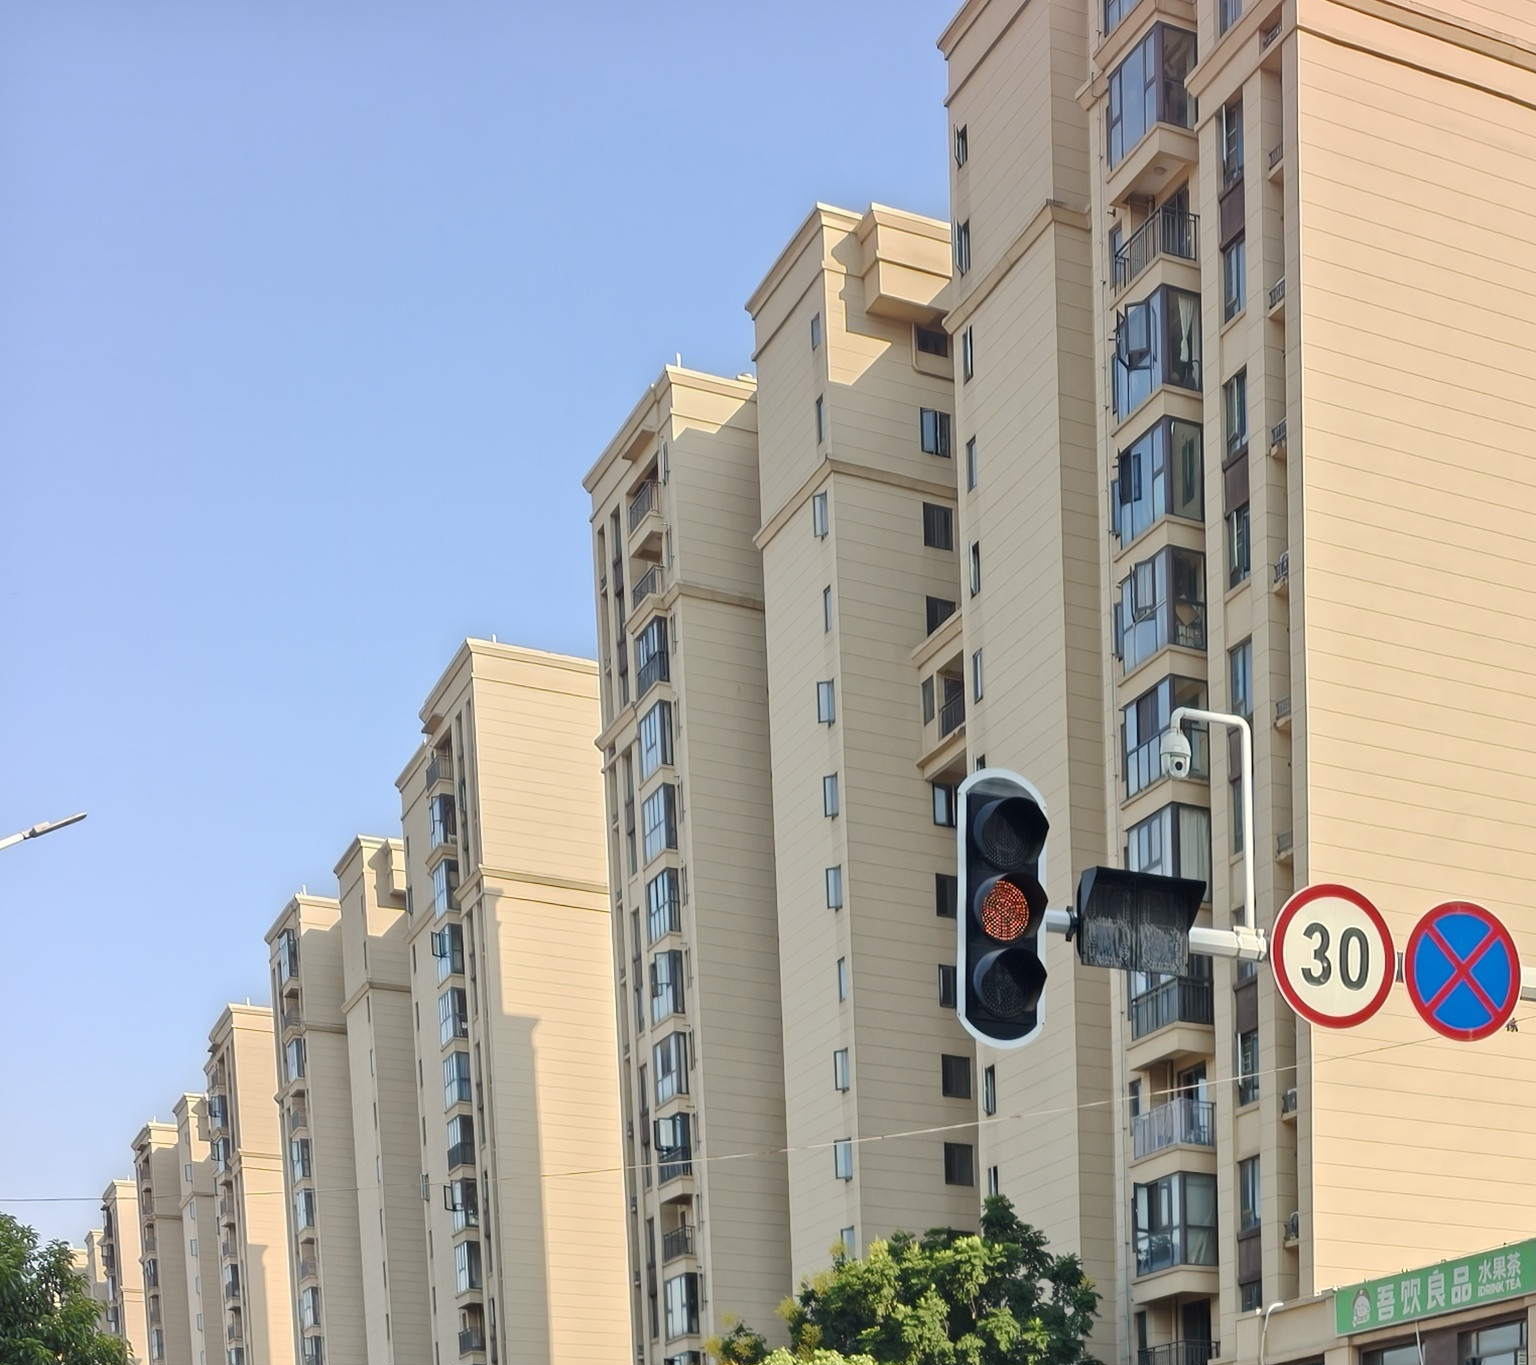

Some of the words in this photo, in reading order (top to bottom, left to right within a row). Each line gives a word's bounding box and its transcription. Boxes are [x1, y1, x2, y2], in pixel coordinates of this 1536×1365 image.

[1301, 922, 1370, 991] 30
[1477, 1251, 1522, 1284] 水果茶
[1505, 1277, 1522, 1292] TEA
[1376, 1265, 1473, 1322] 吾饮良品
